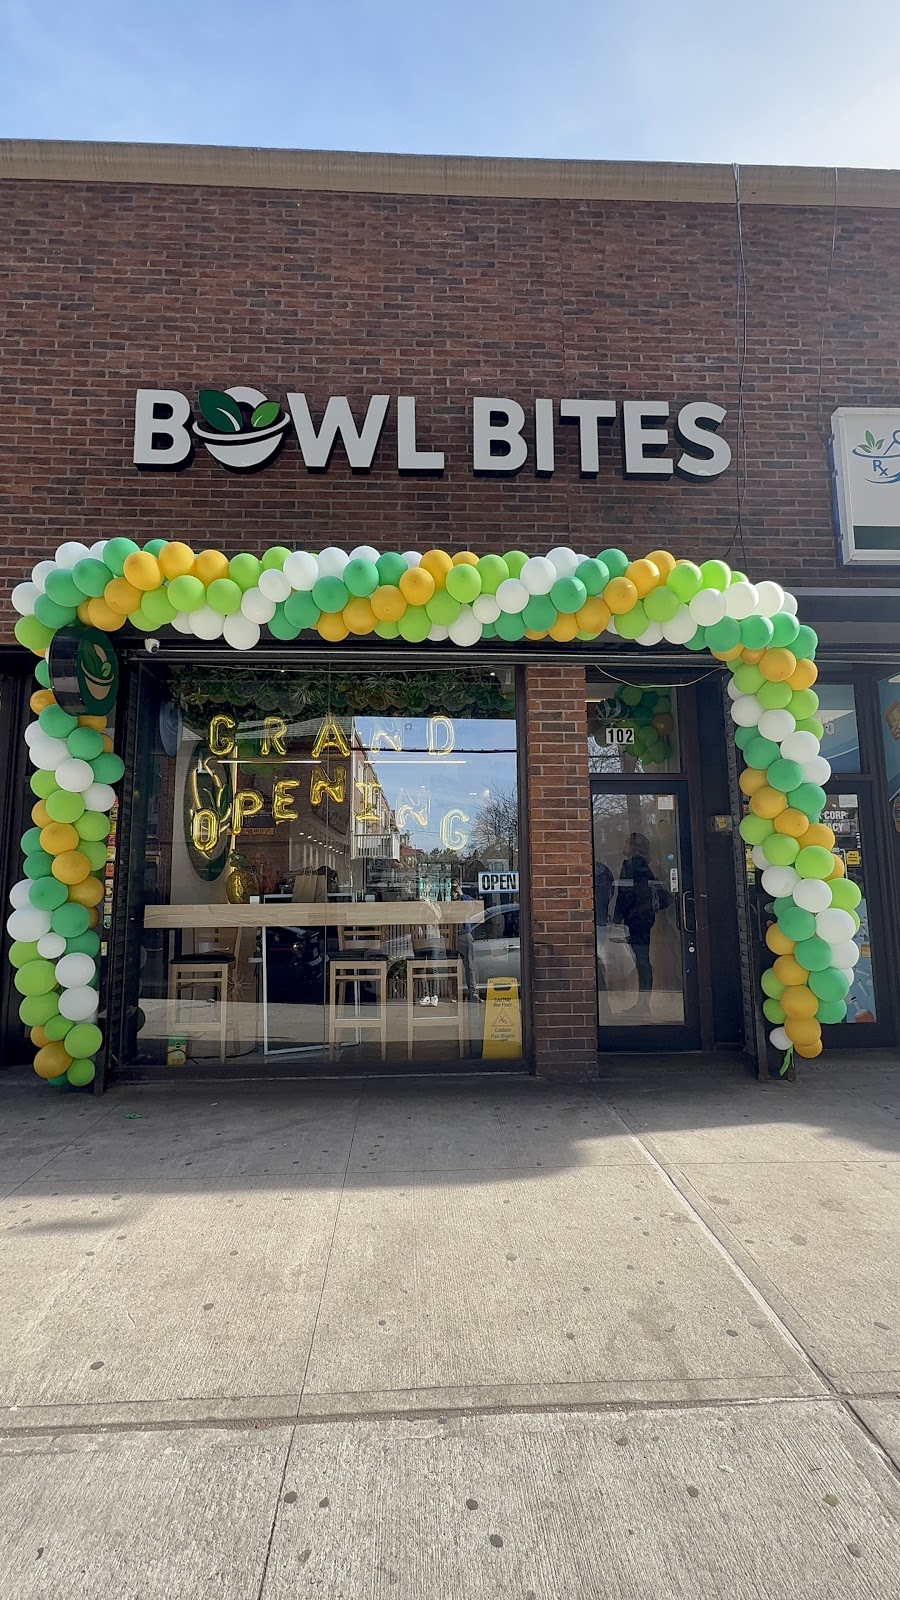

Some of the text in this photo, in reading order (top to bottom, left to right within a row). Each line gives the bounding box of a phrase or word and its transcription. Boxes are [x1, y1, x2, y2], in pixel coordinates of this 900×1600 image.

[133, 386, 732, 477] BOWL BITES
[208, 712, 456, 759] GRAND
[608, 729, 632, 743] 102
[190, 765, 470, 852] OPENING
[824, 810, 846, 820] CORP
[481, 874, 517, 890] OPEN
